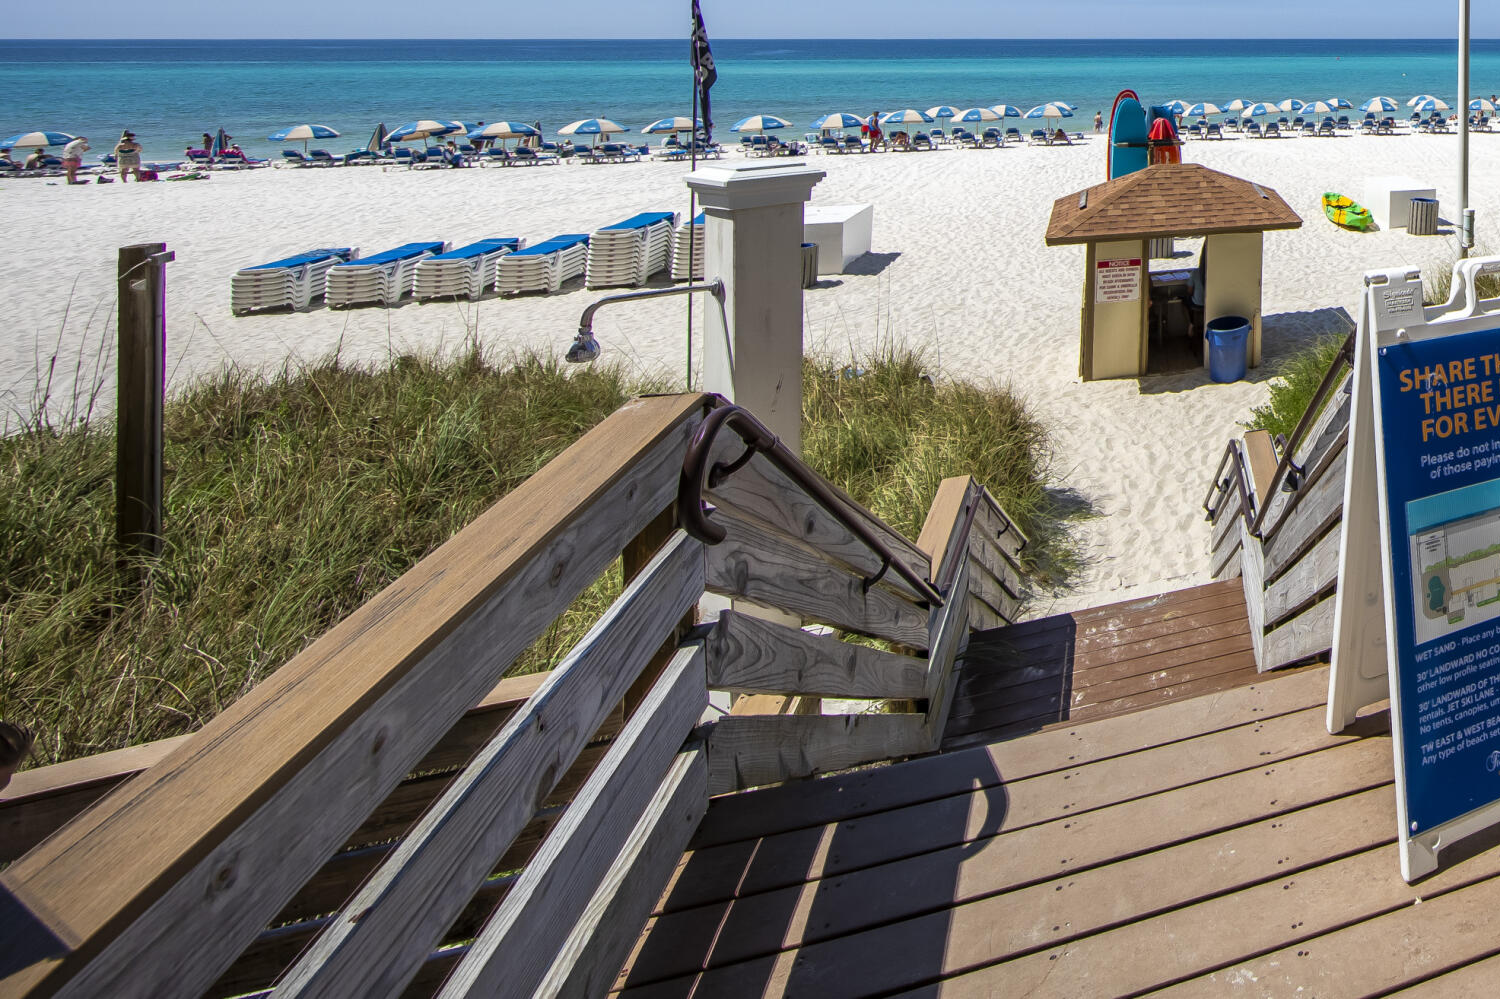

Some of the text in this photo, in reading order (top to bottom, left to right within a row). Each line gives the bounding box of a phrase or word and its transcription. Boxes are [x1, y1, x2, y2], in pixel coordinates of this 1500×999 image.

[1400, 358, 1477, 392] SHARE
[1420, 380, 1494, 414] THERE
[1422, 412, 1468, 442] FOR
[1420, 451, 1454, 467] Please
[1456, 446, 1470, 458] do
[1472, 441, 1489, 455] not
[1430, 465, 1441, 479] of
[1443, 461, 1472, 476] those
[1416, 649, 1433, 663] WET
[1434, 641, 1456, 656] SAND
[1461, 634, 1480, 646] Place
[1481, 628, 1495, 639] any
[1416, 670, 1429, 683] 30'
[1429, 654, 1475, 679] LANDWARD
[1476, 649, 1488, 660] NO
[1417, 680, 1438, 693] other
[1439, 674, 1453, 685] low
[1454, 665, 1478, 682] profile
[1418, 700, 1430, 713] 30'
[1431, 683, 1477, 708] LANDWARD
[1478, 679, 1488, 689] OF
[1419, 708, 1446, 723] rentals.
[1447, 700, 1459, 713] JET
[1461, 696, 1474, 707] SKI
[1474, 687, 1494, 701] LANE
[1420, 725, 1431, 735] No
[1432, 717, 1454, 730] tents,
[1455, 703, 1489, 720] canopies,
[1421, 741, 1435, 754] TW
[1435, 733, 1455, 748] EAST
[1456, 730, 1463, 740] &
[1464, 721, 1485, 737] WEST
[1422, 754, 1437, 766] Any
[1438, 746, 1456, 760] type
[1456, 741, 1465, 751] of
[1466, 732, 1489, 748] beach
